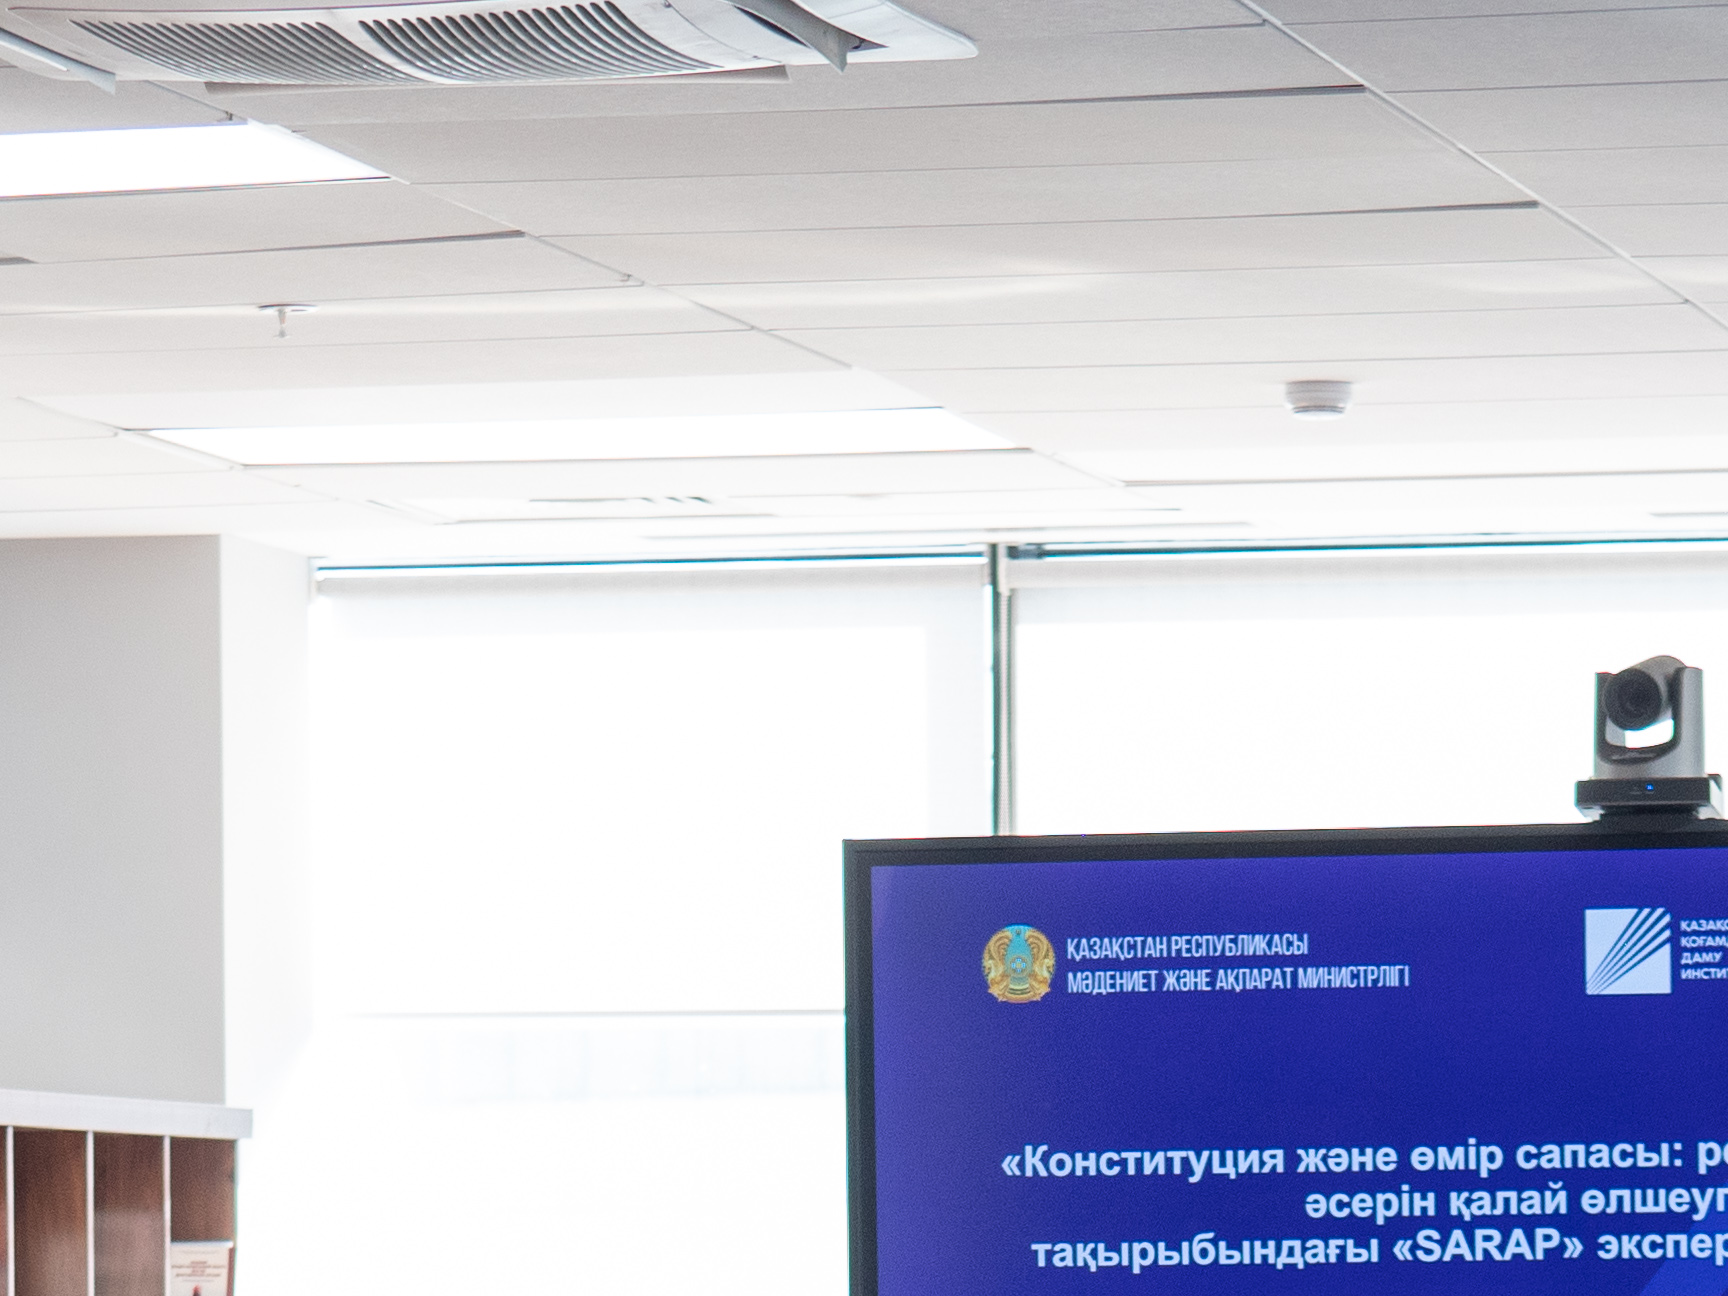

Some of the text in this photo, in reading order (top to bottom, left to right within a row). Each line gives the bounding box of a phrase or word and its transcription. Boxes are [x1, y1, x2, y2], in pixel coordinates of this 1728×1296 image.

[1067, 932, 1309, 962] ҚАЗАҚСТАН РЕСПУБЛИКАСЫ
[1680, 952, 1722, 965] ДАМУ
[1067, 964, 1410, 996] МӘДЕНИЕТ ЖӘНЕ АҚПАРАТ МИНИСТРЛІГІ
[1001, 1144, 1285, 1183] «Конституция
[1296, 1144, 1398, 1174] және
[1410, 1138, 1504, 1177] өмір
[1516, 1139, 1683, 1169] сапасы:
[1305, 1184, 1435, 1225] әсерін
[1449, 1182, 1568, 1221] қалай
[1031, 1232, 1380, 1274] тақырыбындағы
[1393, 1228, 1584, 1262] «SARAP»
